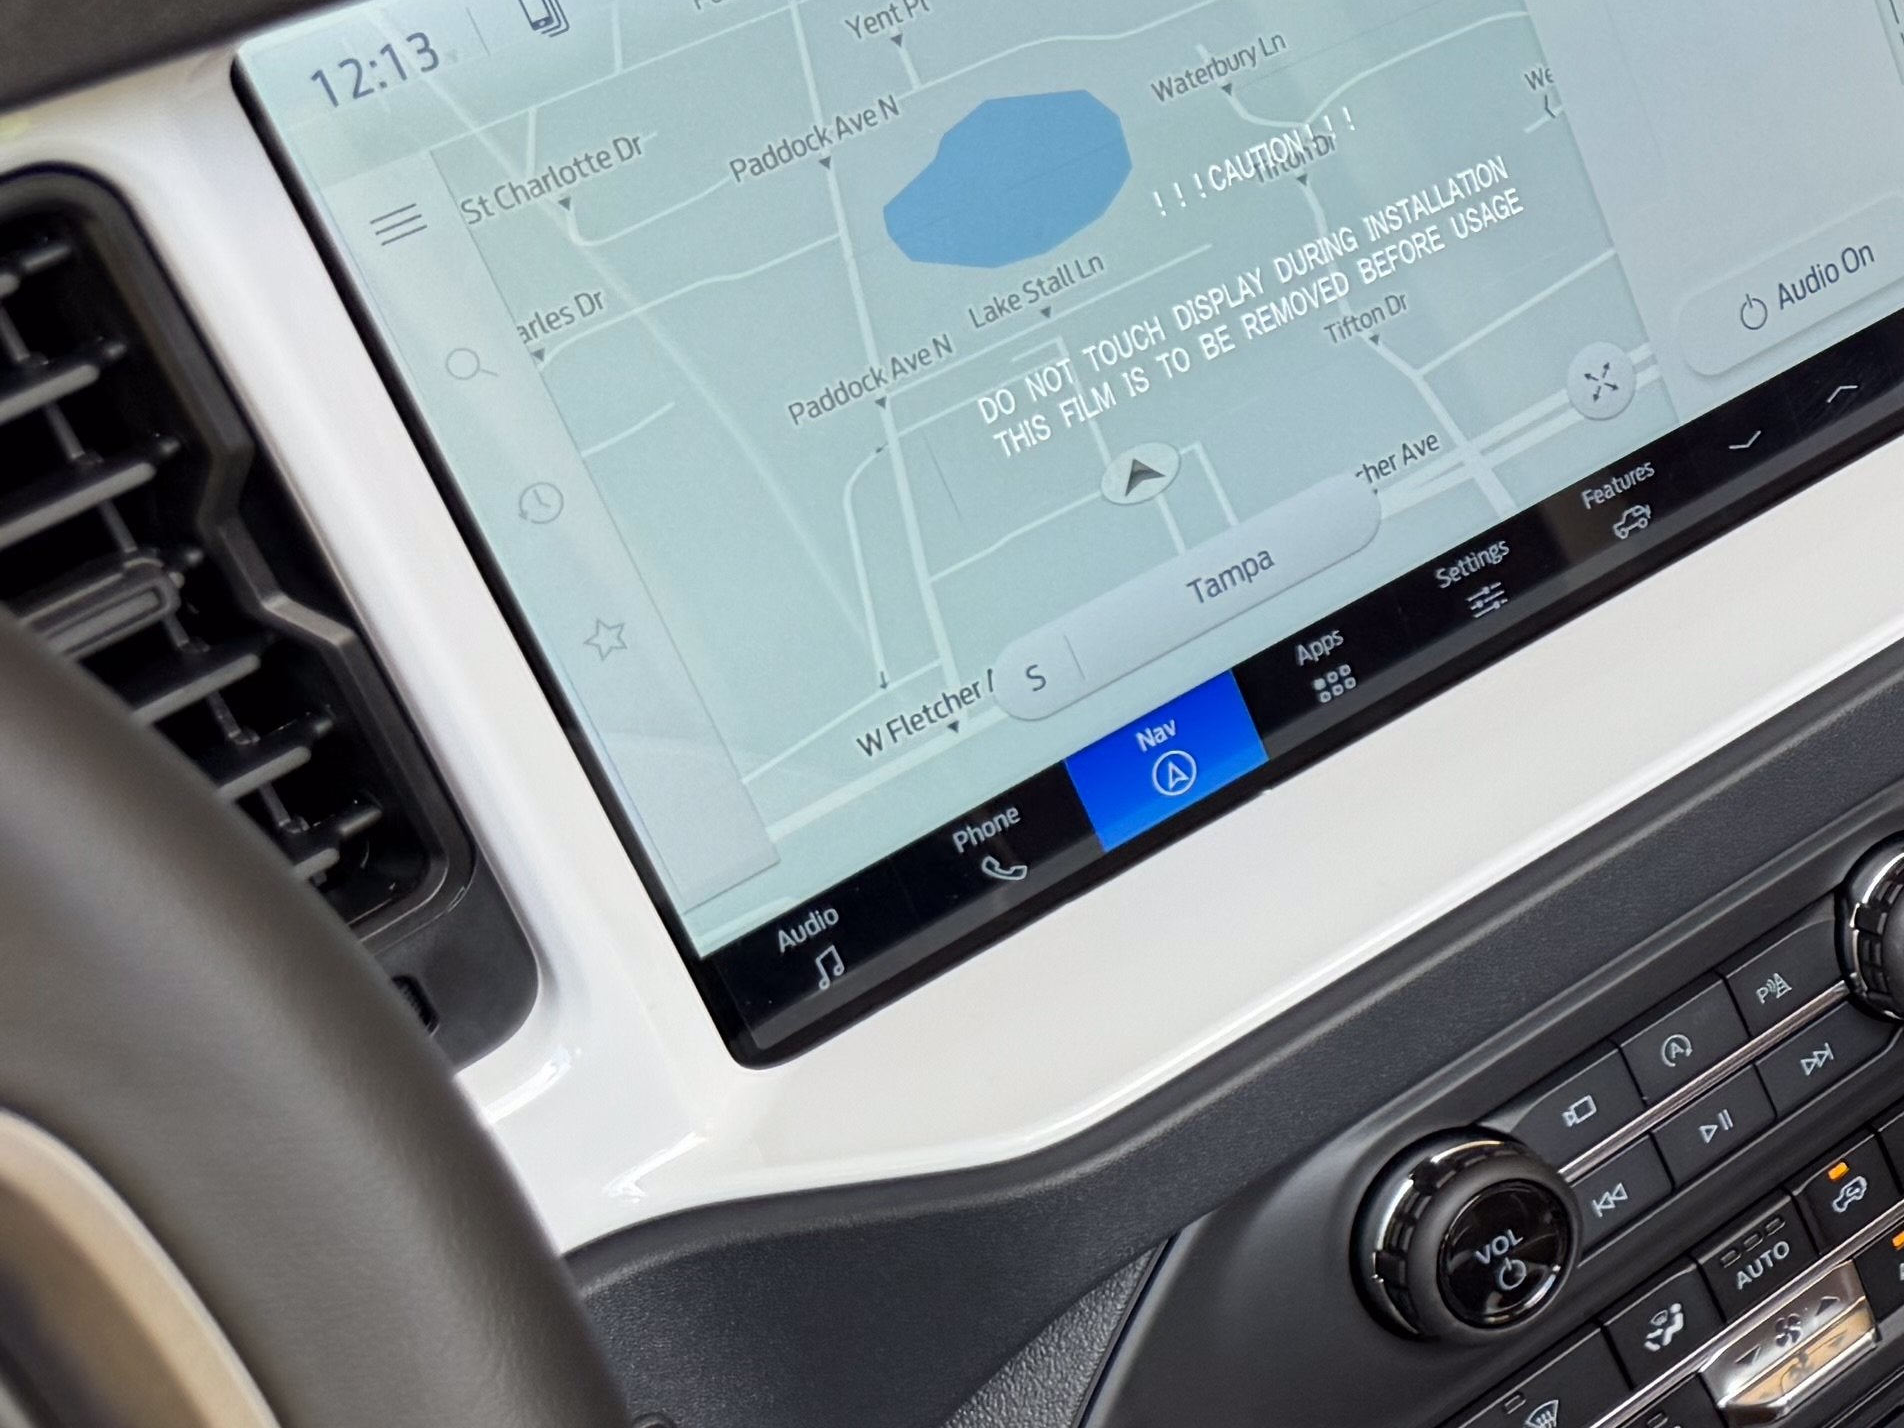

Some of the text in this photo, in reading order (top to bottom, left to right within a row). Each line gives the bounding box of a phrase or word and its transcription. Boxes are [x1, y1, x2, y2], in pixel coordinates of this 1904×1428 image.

[845, 0, 903, 41] Yent
[309, 31, 440, 108] 12:13
[1150, 32, 1288, 103] Waterbury Ln
[729, 94, 900, 185] Paddock Ave N
[1208, 129, 1304, 191] CAUTION
[460, 132, 645, 226] St Charlotte Dr
[968, 254, 1105, 330] Lake Stall Ln
[977, 155, 1510, 425] DO NOT TOUCH DISPLAY DURING INSTALLATION
[1776, 240, 1875, 311] Audio On
[574, 289, 606, 324] Dr
[994, 187, 1525, 458] THIS FILM IS TO BE REMOVED BEFORE USAGE
[1323, 292, 1409, 347] Tifton Dr
[787, 334, 954, 426] Paddock Ave N
[1355, 433, 1440, 484] her Ave
[1581, 460, 1656, 510] Features
[1186, 547, 1275, 606] Tampa
[1435, 539, 1511, 590] Settings
[1294, 627, 1345, 670] Apps
[1025, 663, 1047, 693] S
[856, 732, 888, 758] W
[885, 678, 982, 745] Fletcher
[1135, 718, 1177, 754] Nav
[952, 803, 1021, 855] Phone
[776, 904, 840, 954] Audio
[1474, 1229, 1524, 1265] VOL
[1735, 1240, 1791, 1290] AUTO
